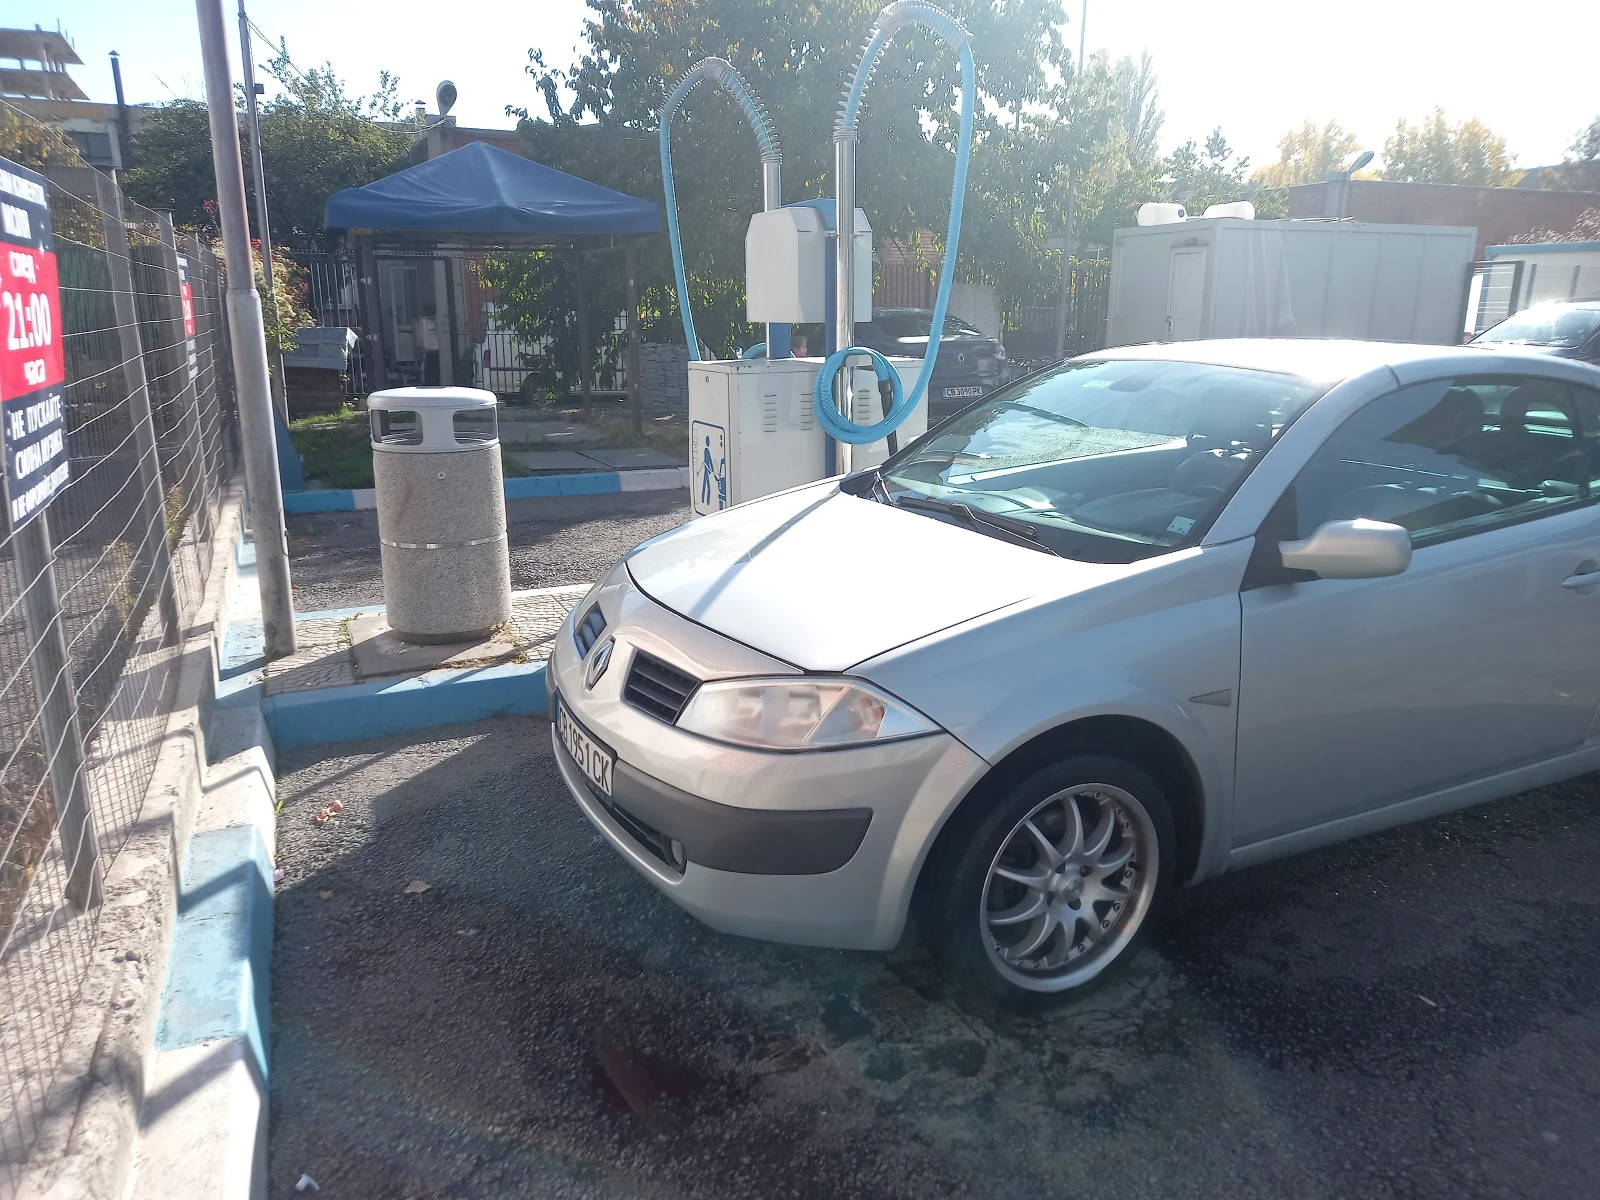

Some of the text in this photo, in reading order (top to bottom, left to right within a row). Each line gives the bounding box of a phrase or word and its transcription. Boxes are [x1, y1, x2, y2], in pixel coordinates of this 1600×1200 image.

[2, 291, 51, 351] 21:00
[11, 393, 61, 441] НЕ ПУСКАЙТЕ
[569, 723, 590, 773] 1951
[593, 749, 610, 793] CK
